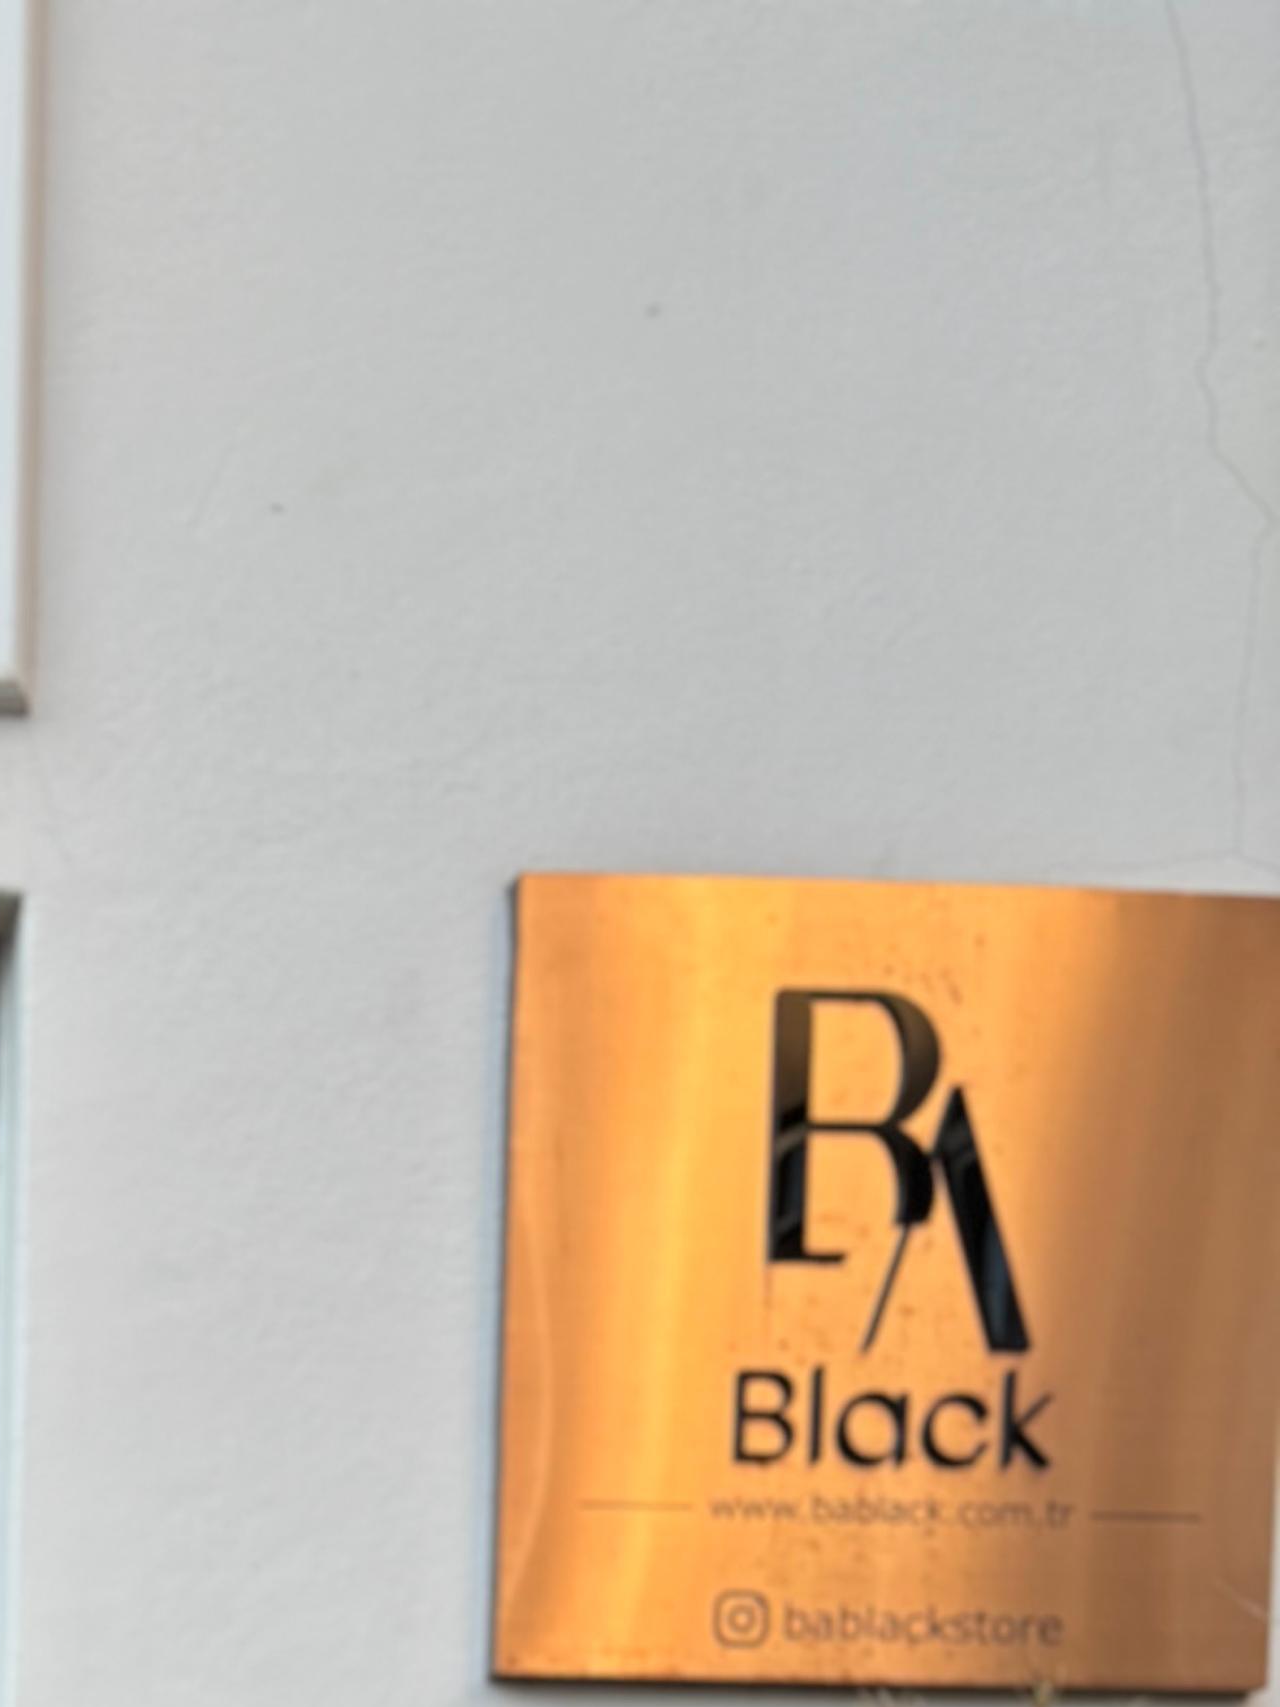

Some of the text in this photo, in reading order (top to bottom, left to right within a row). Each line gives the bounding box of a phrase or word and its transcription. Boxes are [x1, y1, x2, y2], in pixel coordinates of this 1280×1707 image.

[729, 1364, 1055, 1475] Black
[709, 1494, 1077, 1531] www.bablack.com.tr
[784, 1603, 1065, 1650] bablackstore
